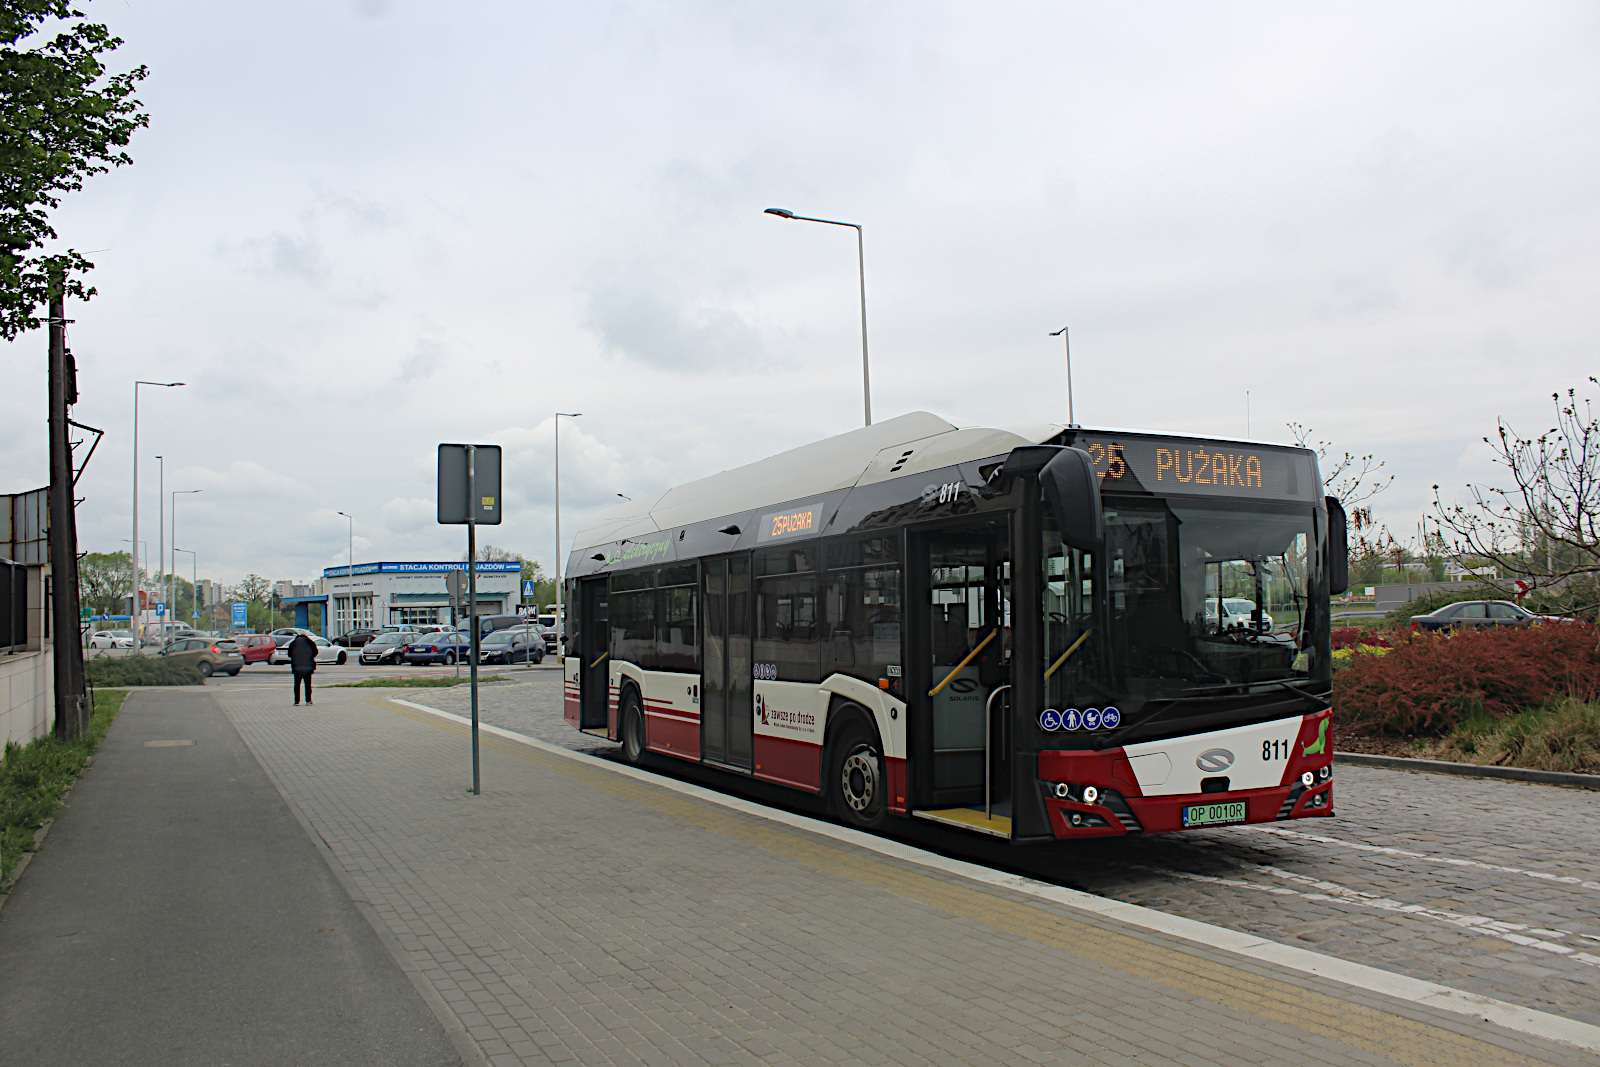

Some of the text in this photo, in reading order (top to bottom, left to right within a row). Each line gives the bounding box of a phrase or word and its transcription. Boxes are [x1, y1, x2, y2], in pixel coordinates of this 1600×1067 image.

[1088, 443, 1262, 488] 25 PUŻAKA
[939, 481, 960, 504] 811
[157, 604, 164, 614] P
[771, 709, 815, 726] zawsze po drodze
[1262, 739, 1288, 761] 811
[1191, 807, 1205, 821] OP
